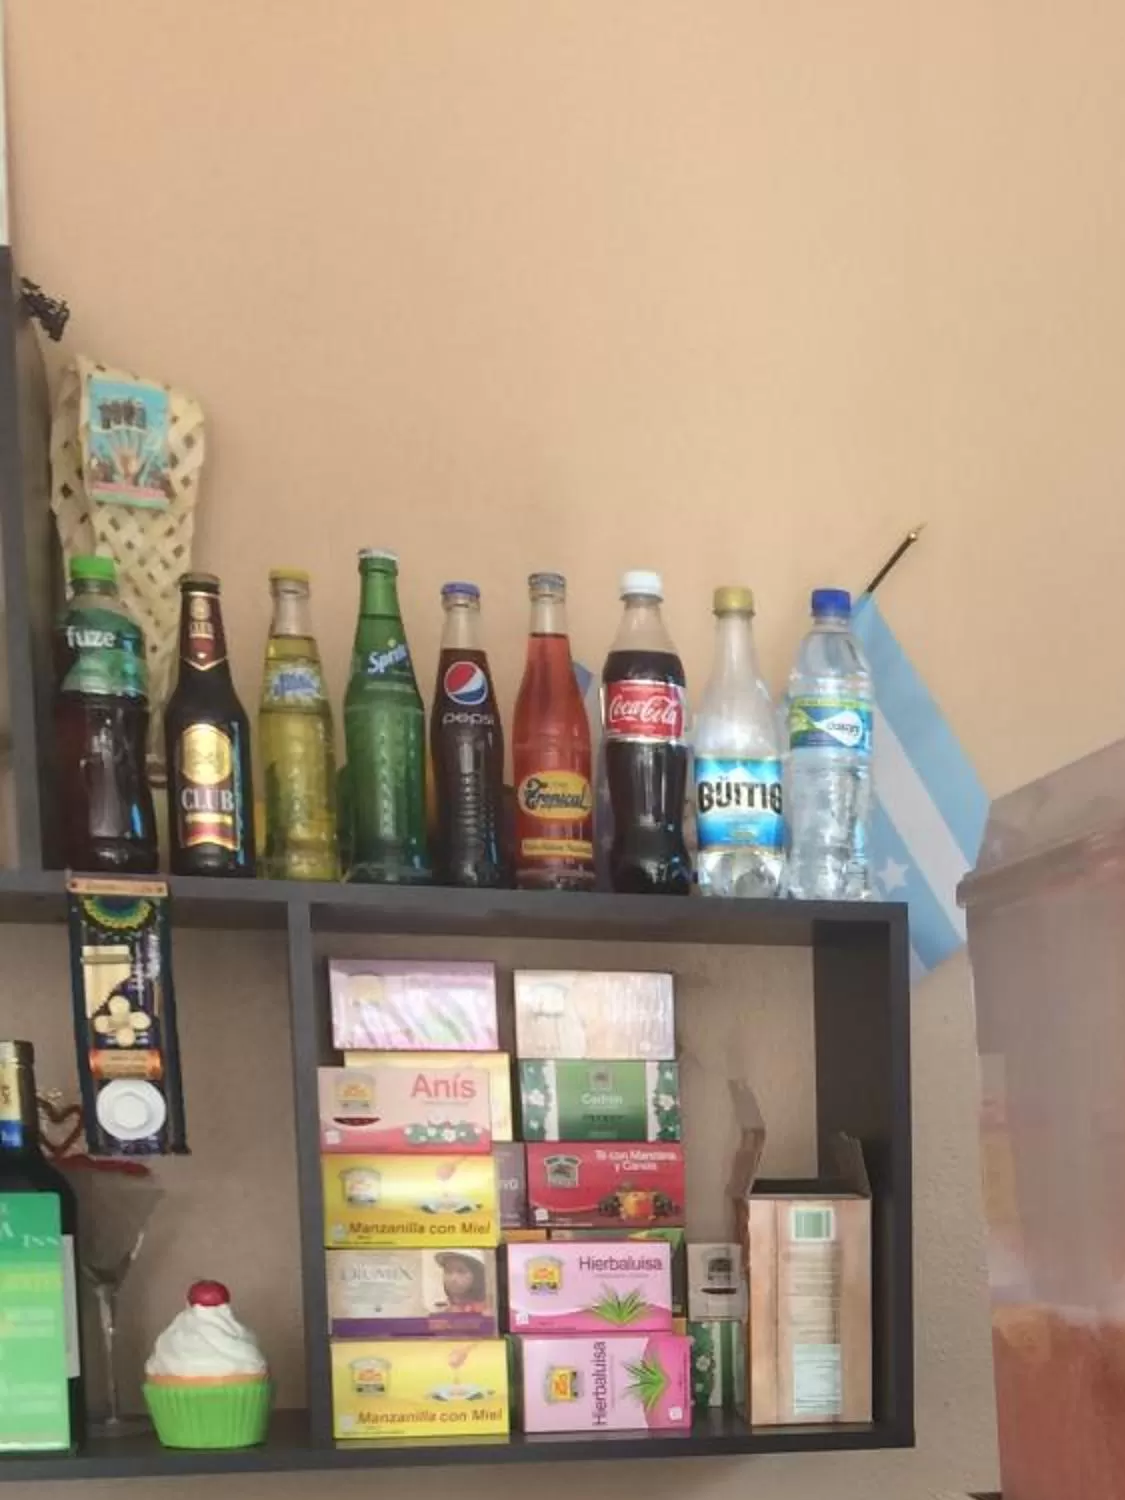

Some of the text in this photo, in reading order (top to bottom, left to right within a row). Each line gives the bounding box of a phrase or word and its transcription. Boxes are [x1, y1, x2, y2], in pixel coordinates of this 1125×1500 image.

[65, 624, 117, 649] fuze
[442, 712, 495, 726] pepsi
[181, 786, 235, 811] CLUB
[410, 1072, 478, 1099] Anís
[347, 1220, 492, 1235] Manzanilla con Miel
[578, 1255, 664, 1272] Hierbaluisa
[591, 1340, 608, 1427] Hierbaluisa
[355, 1407, 503, 1425] Manzanilla con Miel
